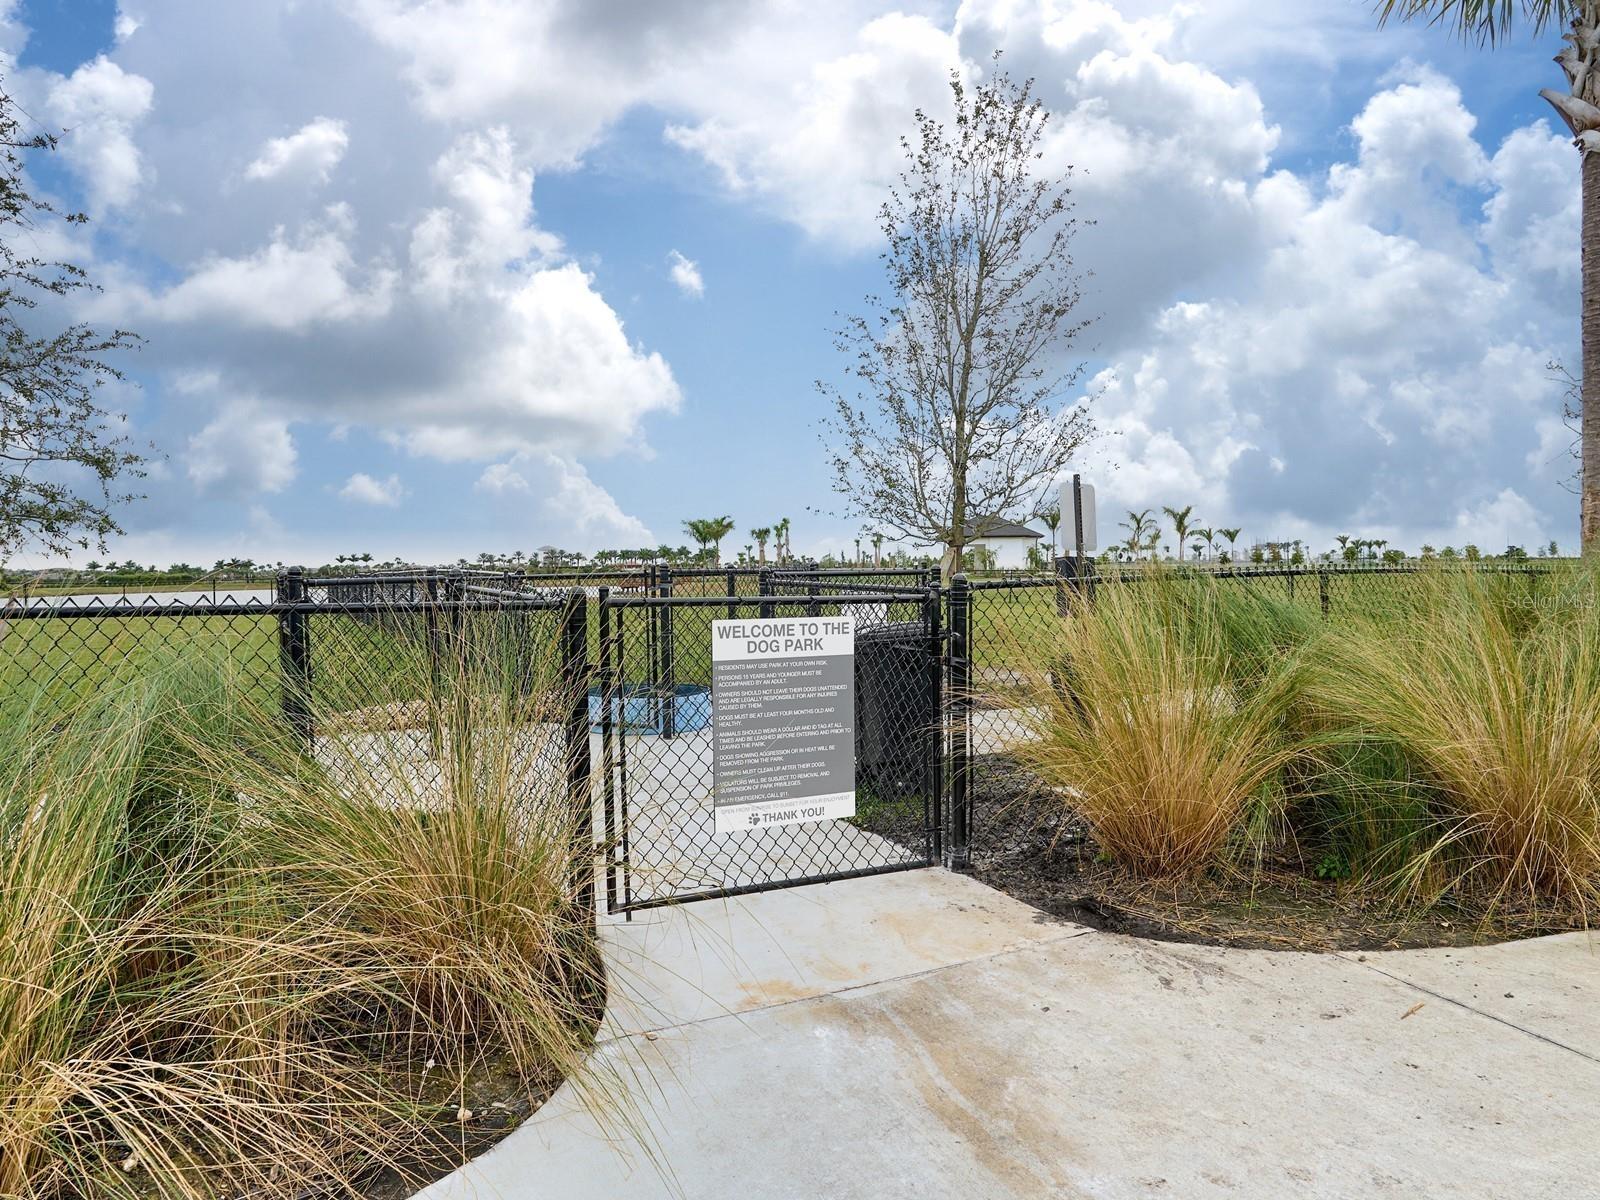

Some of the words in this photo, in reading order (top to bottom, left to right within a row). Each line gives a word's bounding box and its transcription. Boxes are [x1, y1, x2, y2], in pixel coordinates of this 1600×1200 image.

[718, 624, 795, 639] WELCOME
[800, 623, 818, 636] TO
[822, 622, 850, 635] THE
[747, 640, 780, 653] DOG
[784, 638, 823, 652] PARK
[760, 749, 790, 757] AGGRESSION
[763, 811, 798, 823] THANK
[801, 807, 825, 818] YOU!
